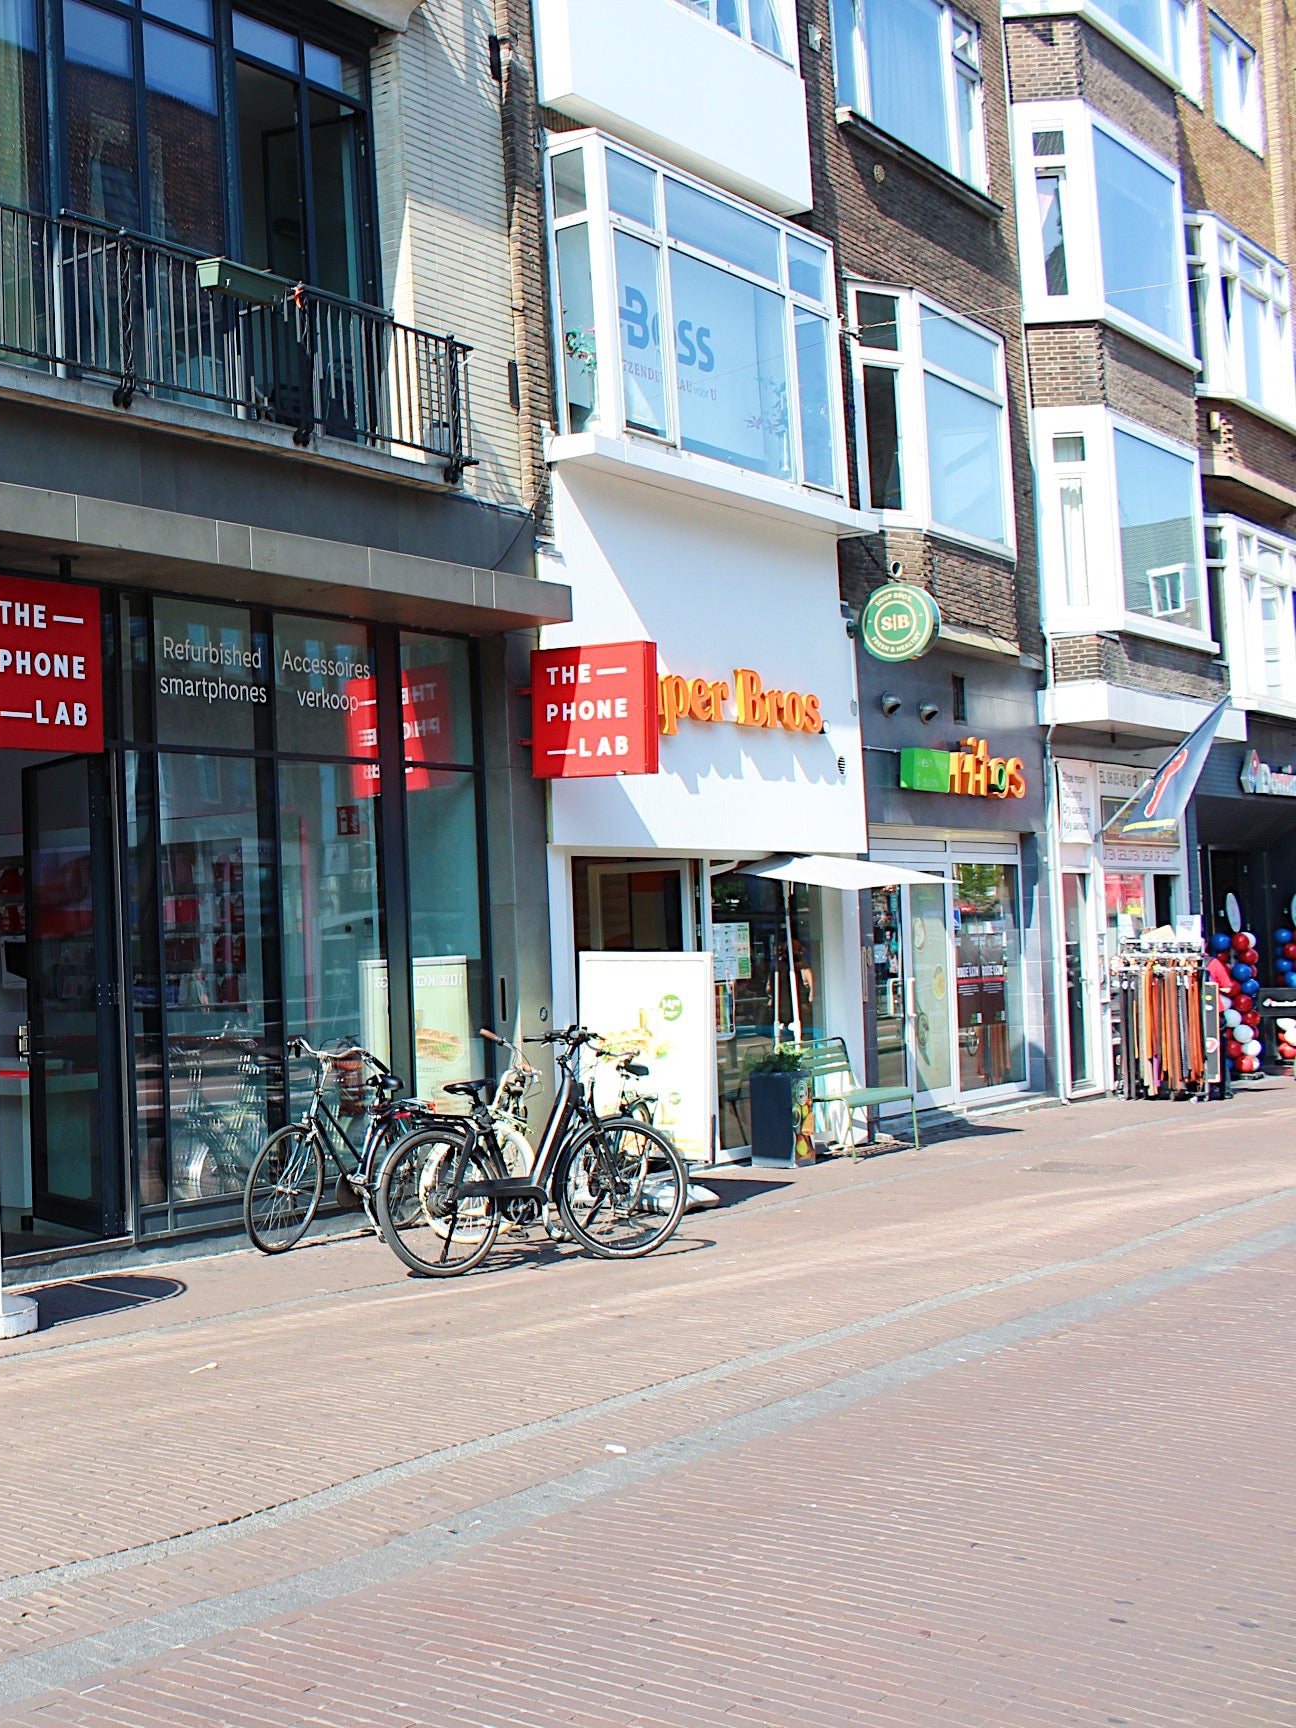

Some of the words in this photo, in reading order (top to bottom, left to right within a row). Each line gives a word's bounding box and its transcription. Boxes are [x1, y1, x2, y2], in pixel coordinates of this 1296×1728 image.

[162, 635, 263, 670] Refurbished
[281, 648, 372, 681] Accessoires
[546, 663, 592, 686] THE
[159, 677, 268, 705] smartphones
[296, 688, 360, 717] verkoop
[658, 674, 730, 735] per
[732, 667, 824, 735] Bros
[34, 698, 89, 728] LAB
[546, 697, 629, 723] PHONE
[579, 735, 629, 758] LAB
